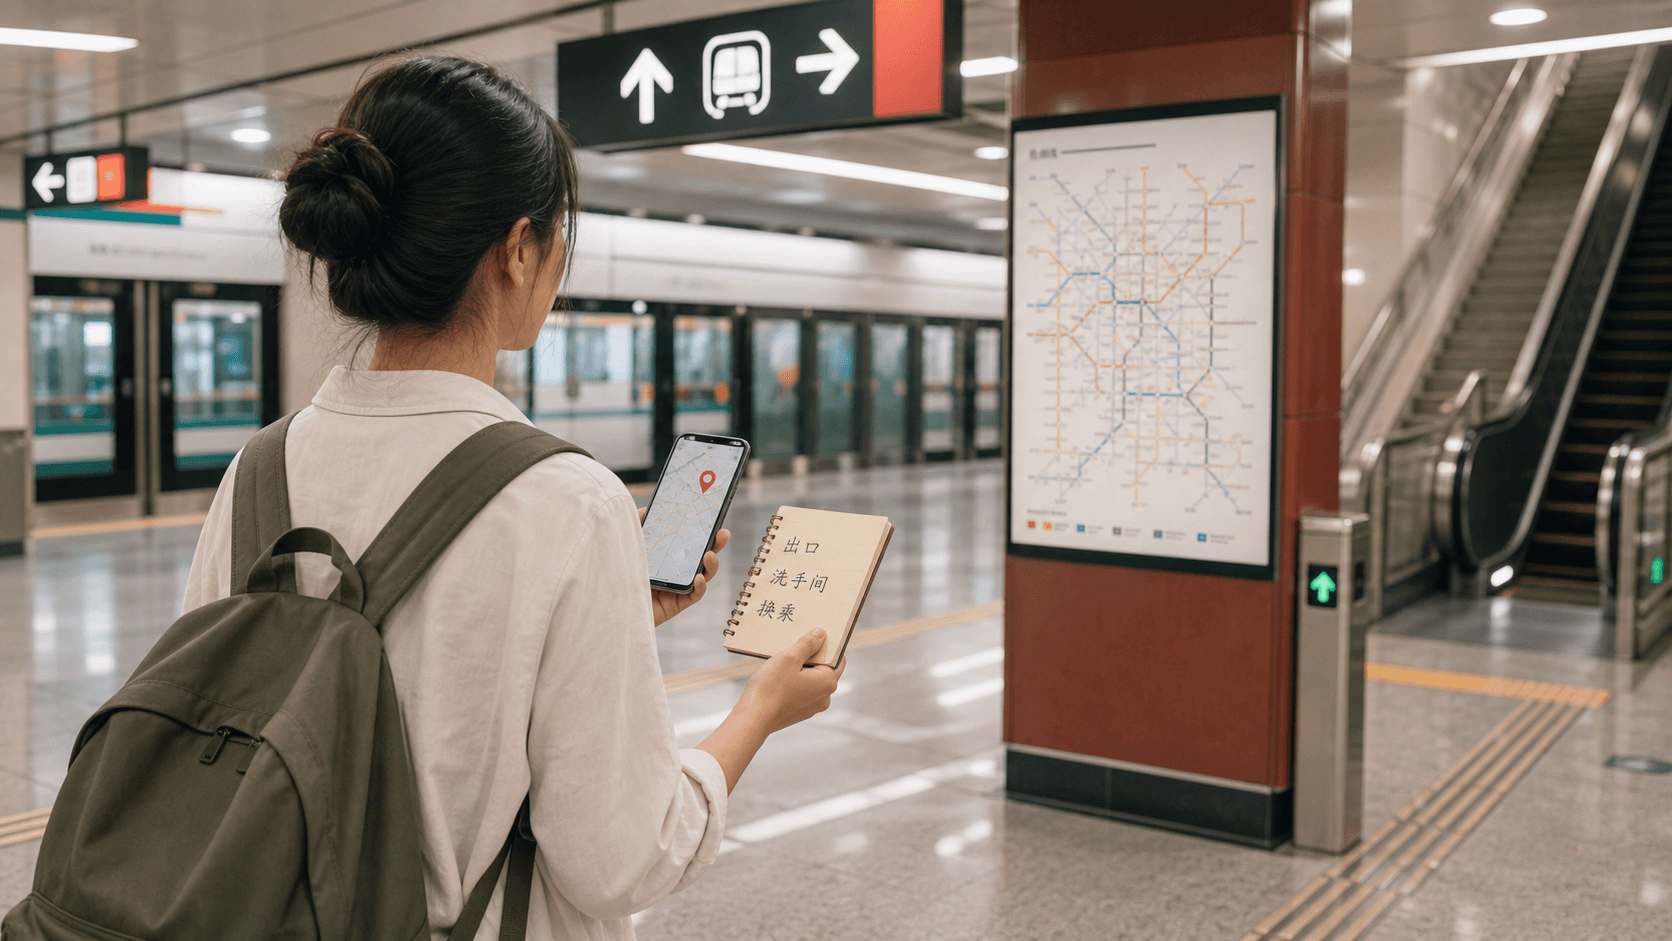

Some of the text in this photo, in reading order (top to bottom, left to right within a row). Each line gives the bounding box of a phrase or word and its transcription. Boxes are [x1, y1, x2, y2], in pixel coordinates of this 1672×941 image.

[783, 536, 820, 554] 出口
[770, 569, 829, 594] 洗手间
[757, 599, 796, 622] 换乘
